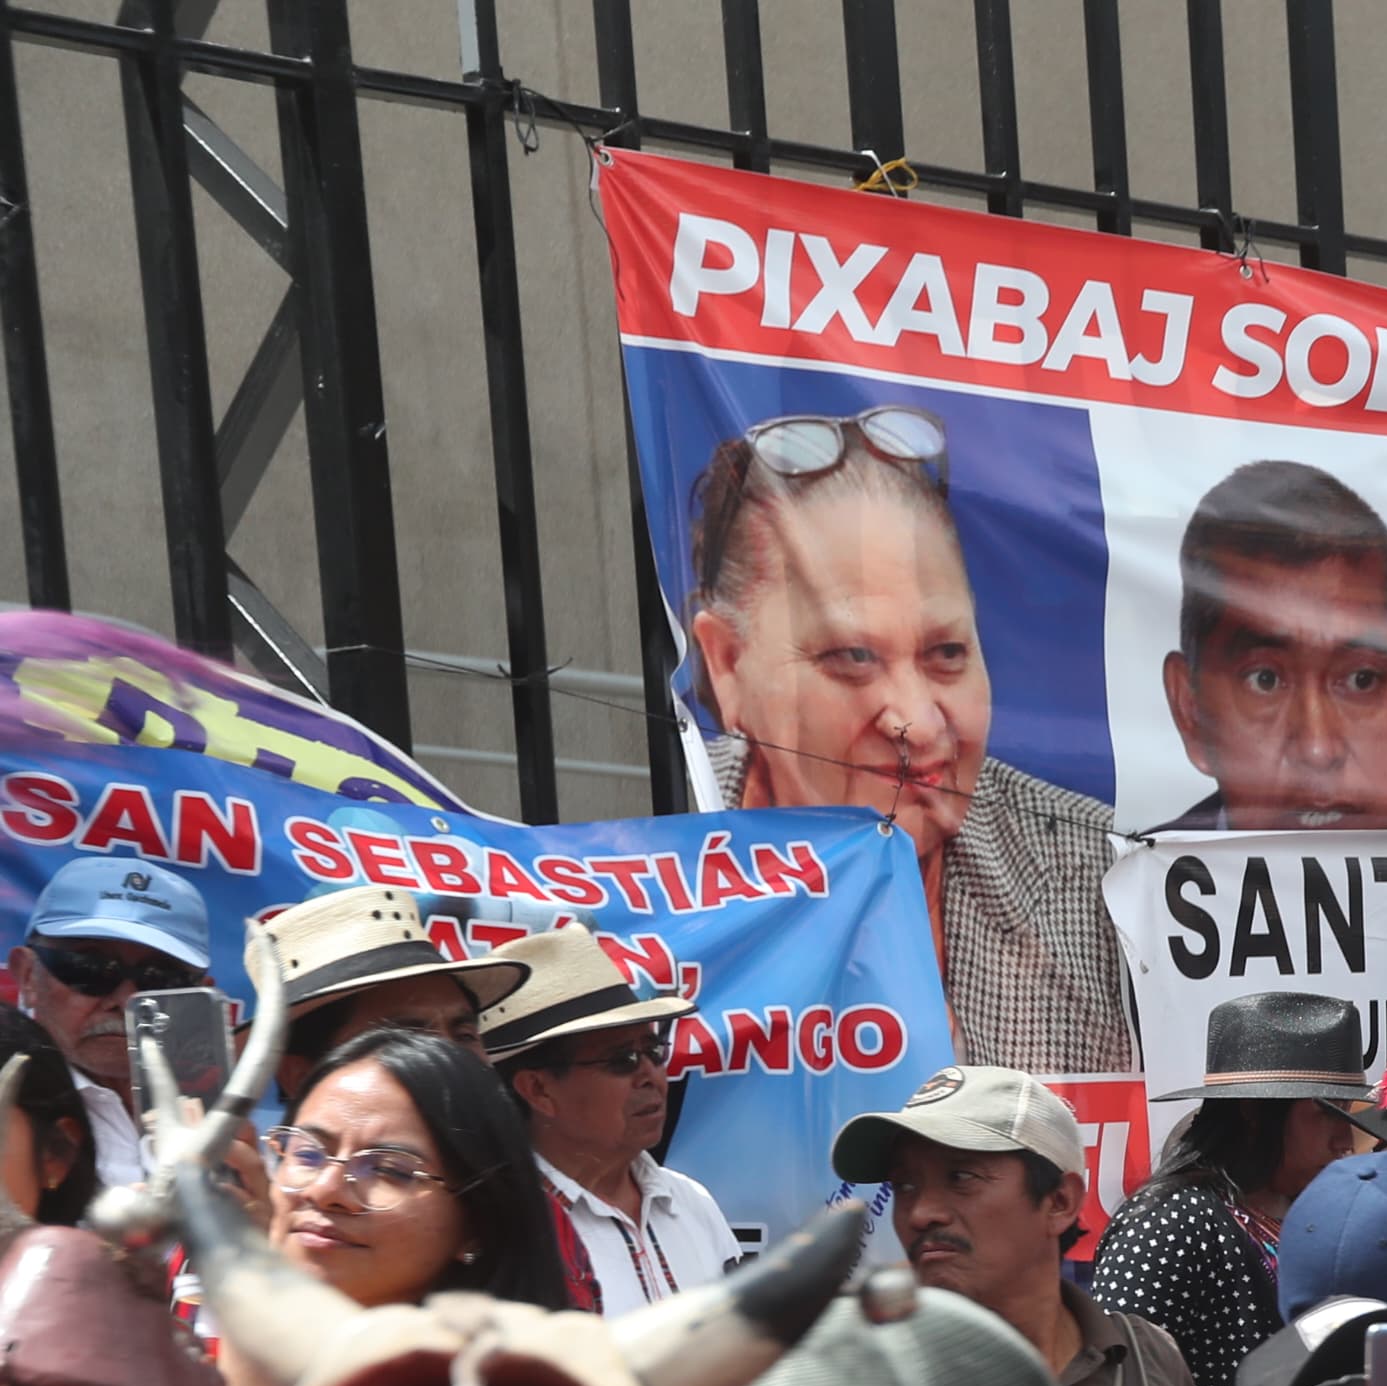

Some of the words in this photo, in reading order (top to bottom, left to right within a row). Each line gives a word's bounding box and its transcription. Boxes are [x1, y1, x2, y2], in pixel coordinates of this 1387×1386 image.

[670, 212, 1194, 387] PIXABAJ
[2, 772, 261, 876] SAN
[285, 830, 828, 916] SEBASTIÁN
